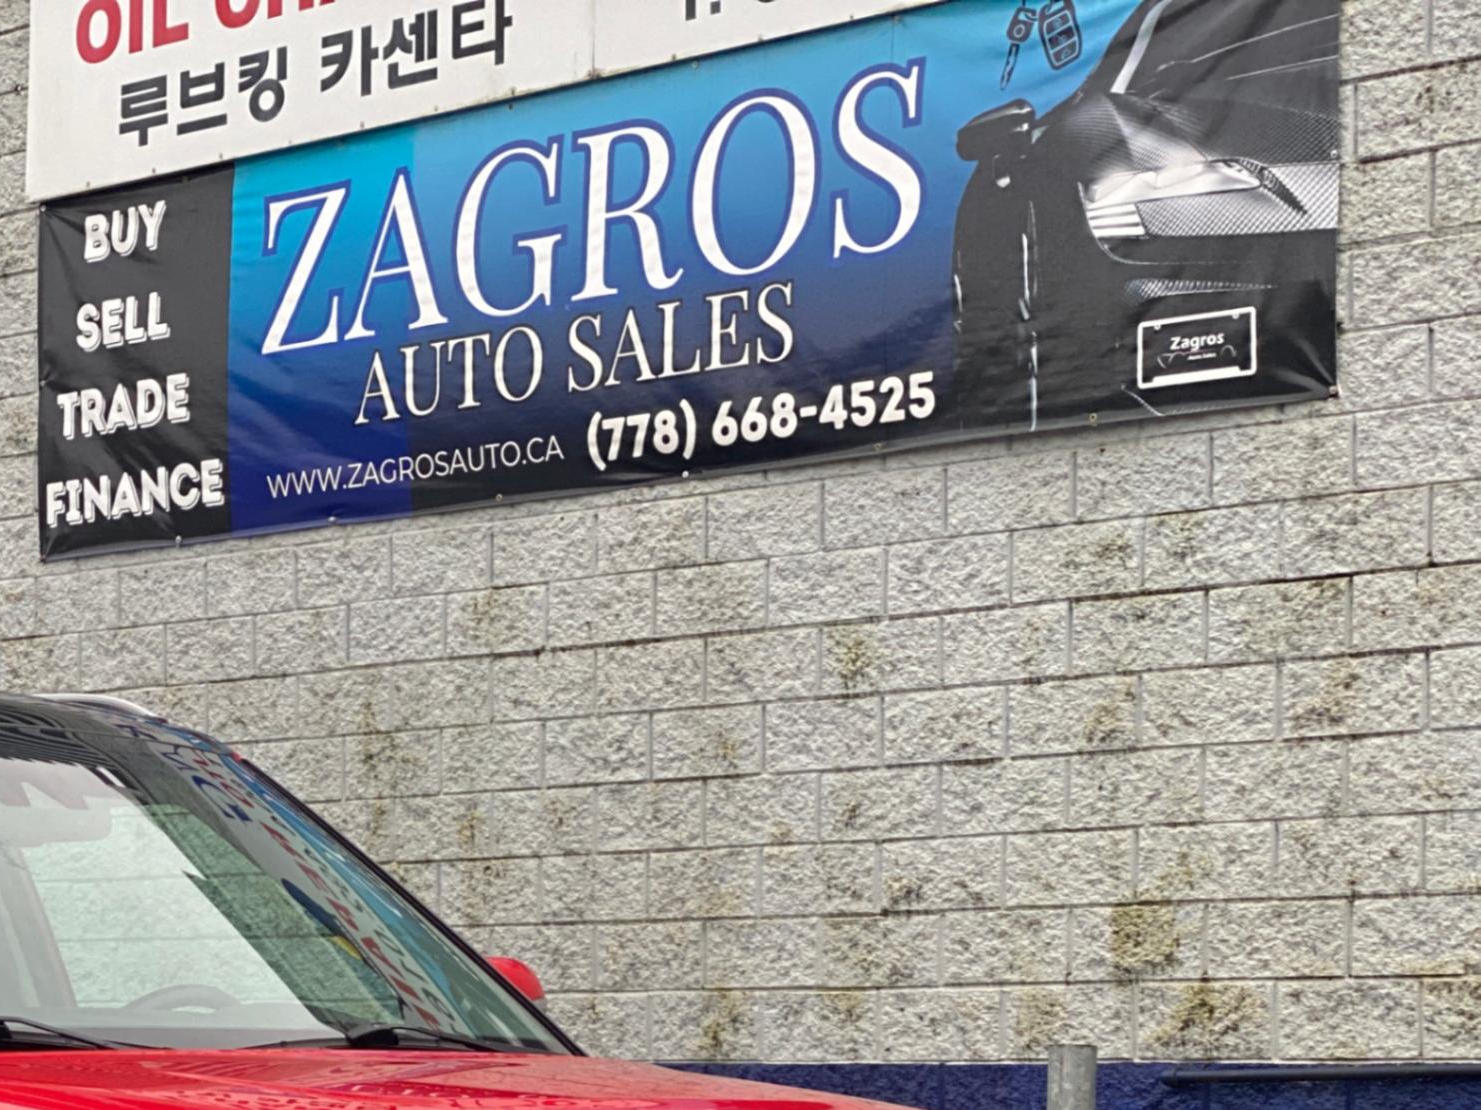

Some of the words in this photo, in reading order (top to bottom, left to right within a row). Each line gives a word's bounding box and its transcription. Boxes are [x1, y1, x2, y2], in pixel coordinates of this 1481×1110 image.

[76, 0, 189, 64] OIL
[119, 46, 287, 147] 루브킹
[320, 0, 513, 96] 카센타
[83, 199, 167, 264] BUY
[261, 64, 923, 355] ZAGROS
[76, 291, 171, 353] SELL
[355, 325, 544, 424] AUTO
[568, 282, 793, 392] SALES
[1169, 332, 1225, 353] Zagros
[56, 373, 191, 441] TRADE
[587, 399, 697, 471] (778)
[711, 371, 937, 446] 668-4525
[46, 458, 225, 529] FINANCE
[266, 435, 565, 499] WWW.ZAGROSAUTO.CA
